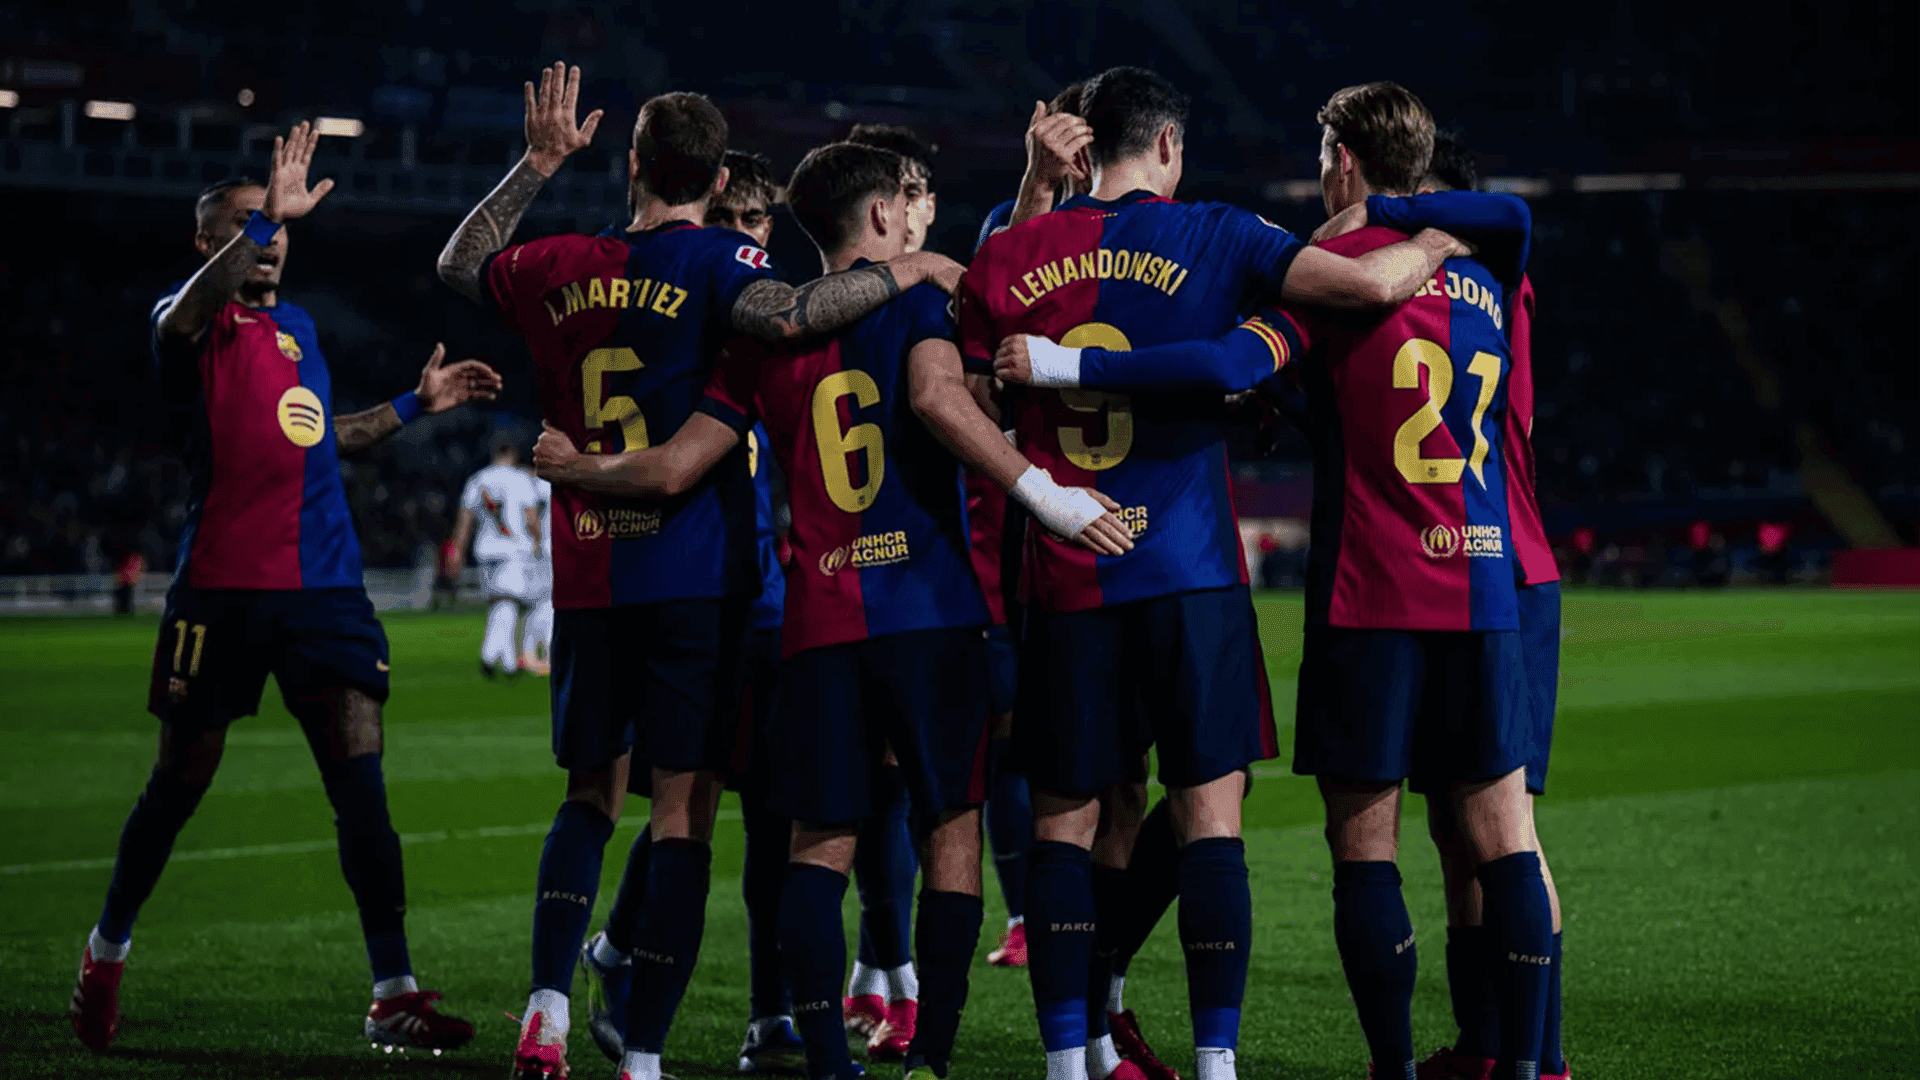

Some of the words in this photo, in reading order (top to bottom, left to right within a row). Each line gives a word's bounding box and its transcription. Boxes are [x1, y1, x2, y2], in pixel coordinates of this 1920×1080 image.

[1009, 248, 1188, 308] LEWANDOWSKI
[581, 347, 651, 453] 5
[1057, 321, 1134, 472] 9
[1392, 338, 1502, 492] 21
[812, 368, 885, 513] 6
[850, 543, 909, 562] ACNUR
[851, 530, 907, 550] UNHCR
[173, 618, 207, 678] 11
